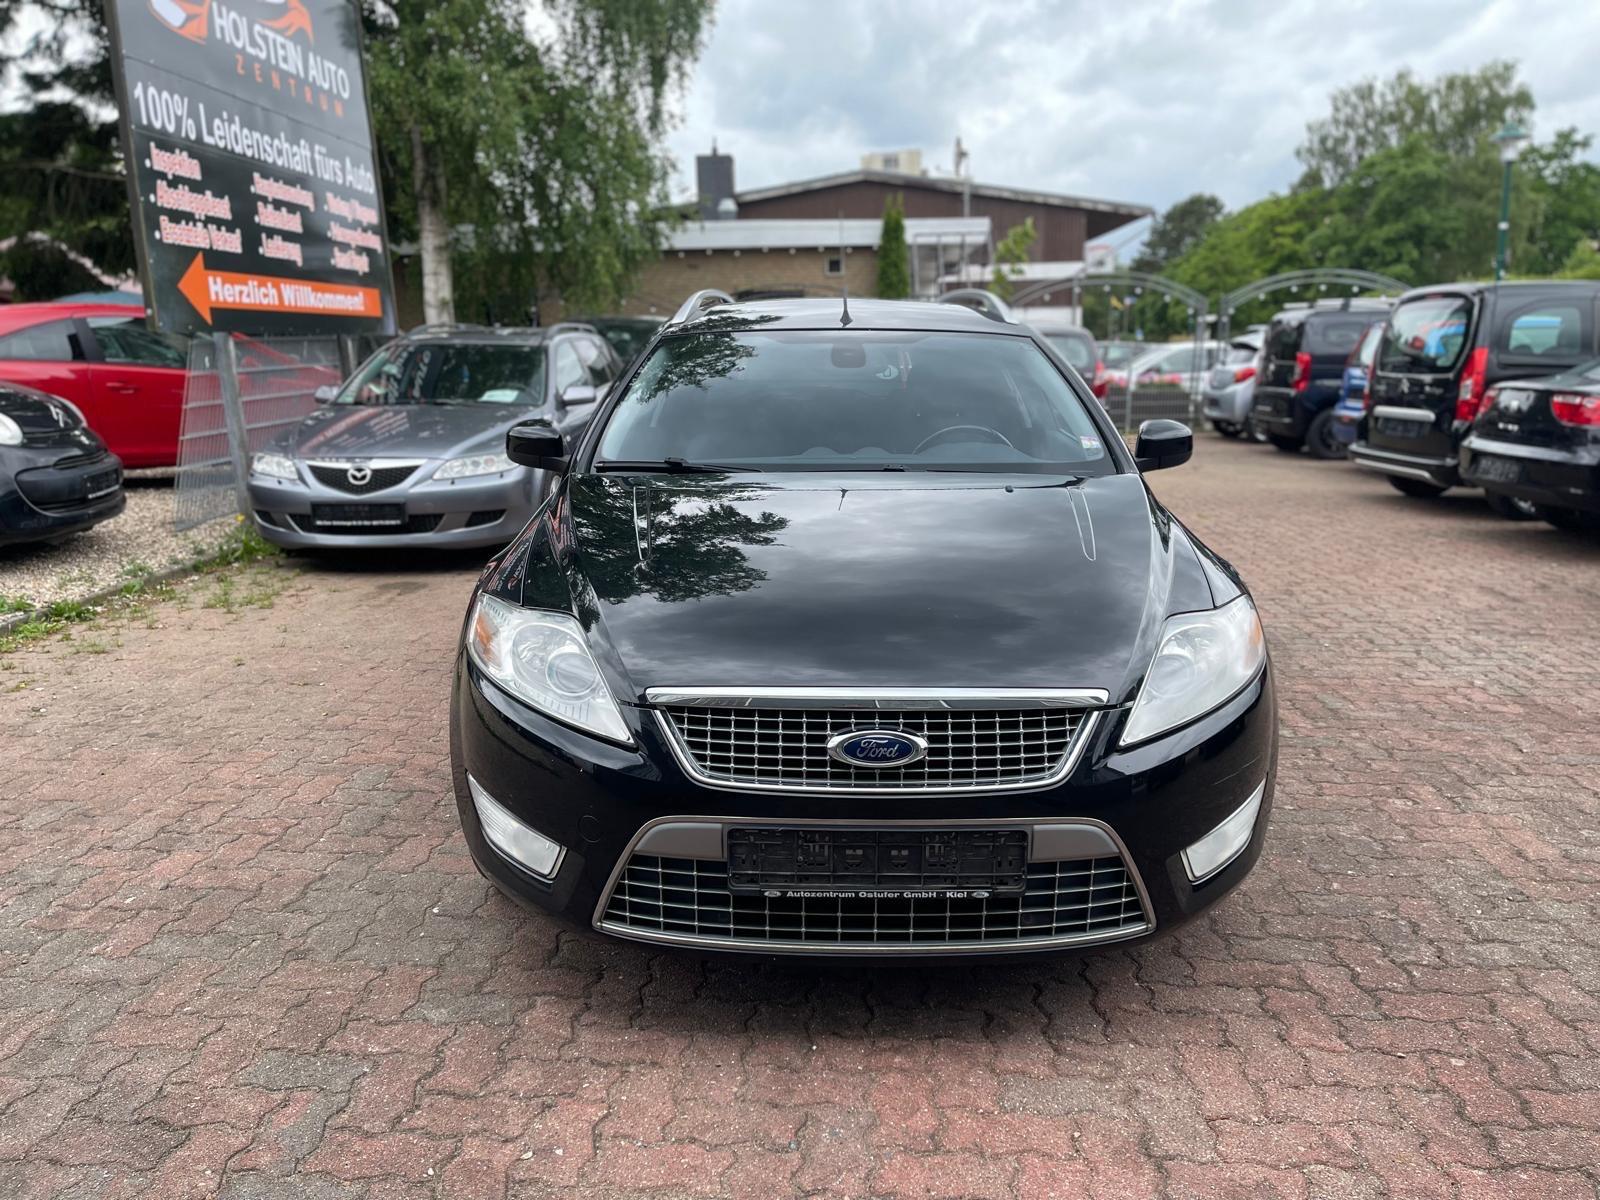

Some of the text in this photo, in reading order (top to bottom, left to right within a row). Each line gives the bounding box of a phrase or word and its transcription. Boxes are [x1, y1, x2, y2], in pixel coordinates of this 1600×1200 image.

[211, 1, 350, 100] HOLSTEIN AUTO
[234, 53, 344, 118] ZENTRUM
[133, 81, 197, 141] 100%
[198, 103, 314, 177] Leidenschaft
[314, 143, 343, 186] fürs
[344, 157, 376, 195] Auto
[207, 275, 365, 311] Herzlich Willkommen!
[856, 738, 901, 758] Ford
[786, 890, 856, 898] Autozentrum
[858, 890, 900, 898] Ostufer
[903, 891, 937, 899] GmbH
[946, 890, 968, 898] Kiel
